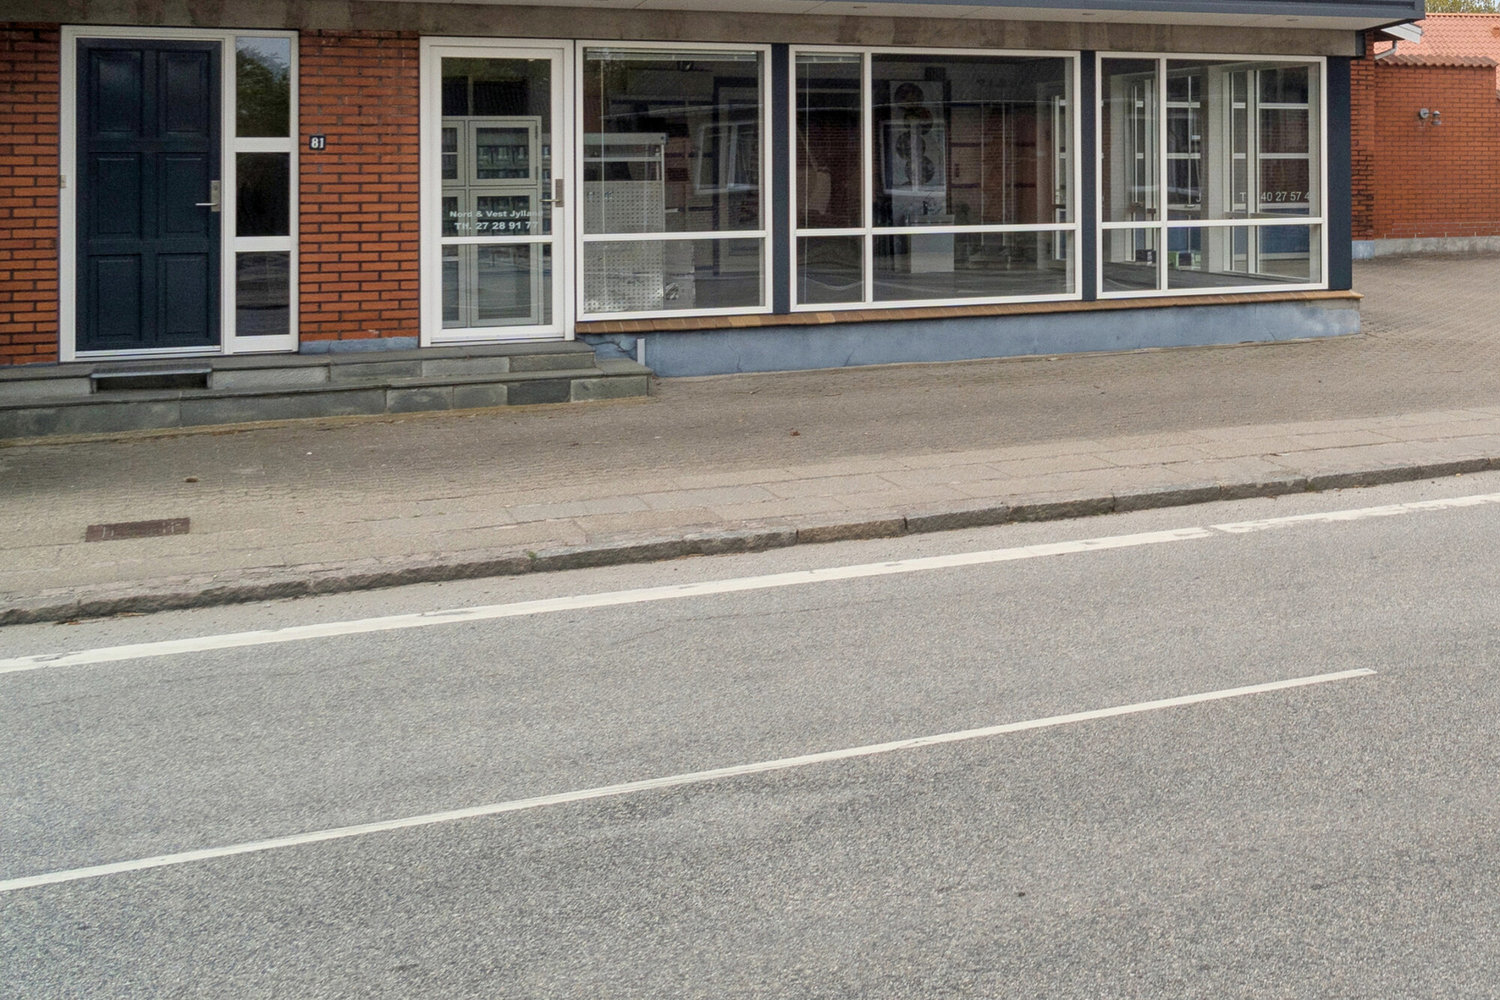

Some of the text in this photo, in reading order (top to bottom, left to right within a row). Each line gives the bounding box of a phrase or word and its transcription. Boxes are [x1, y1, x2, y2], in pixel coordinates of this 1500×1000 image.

[311, 136, 324, 149] 81
[1261, 191, 1273, 202] 40
[1275, 191, 1287, 202] 27
[1290, 191, 1302, 202] 57
[449, 210, 473, 218] Nord
[475, 222, 489, 230] 27
[492, 221, 506, 230] 28
[508, 221, 522, 230] 91
[525, 221, 538, 229] 77
